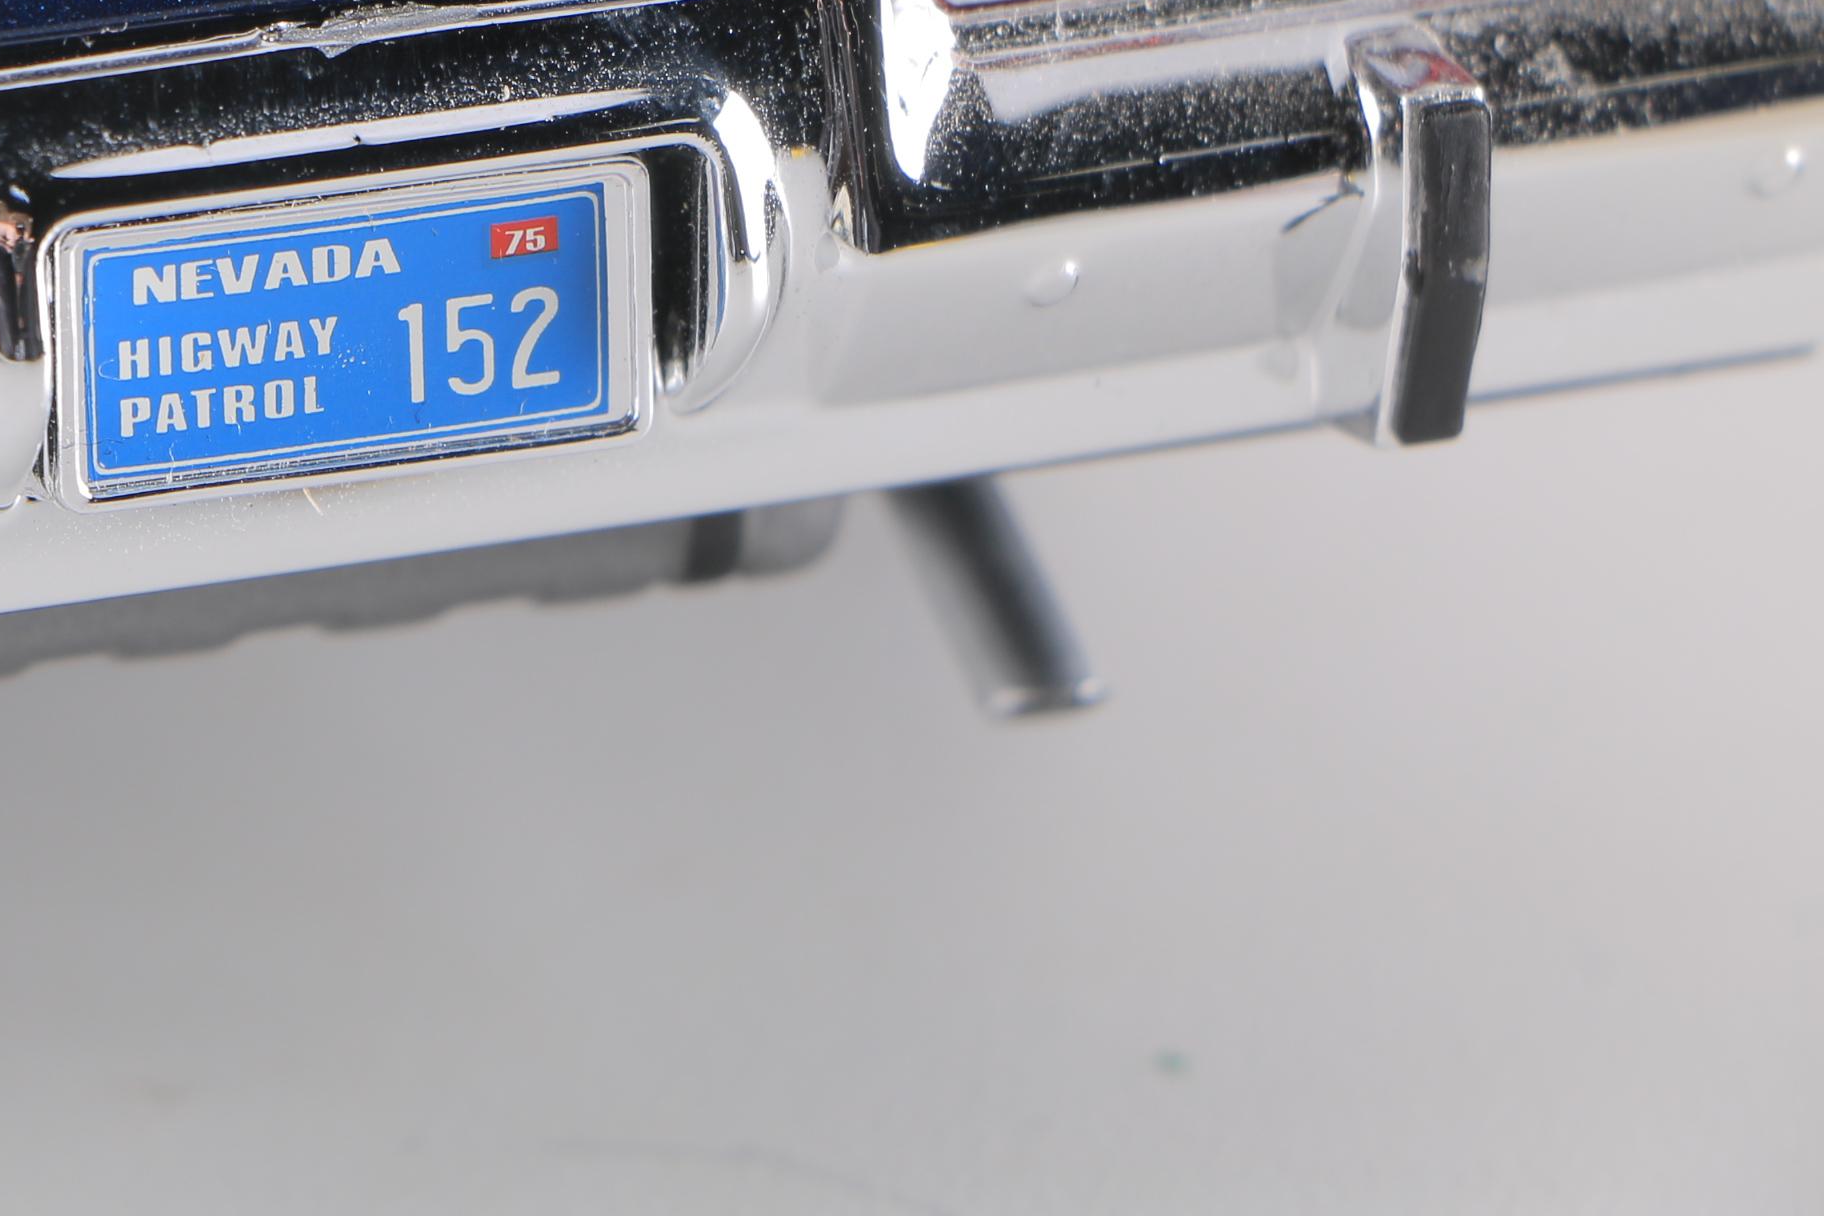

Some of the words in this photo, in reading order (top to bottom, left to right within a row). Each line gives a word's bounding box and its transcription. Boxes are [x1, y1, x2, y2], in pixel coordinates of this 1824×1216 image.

[132, 237, 402, 306] NEVADA
[504, 226, 546, 256] 75
[119, 315, 338, 380] HIGWAY
[398, 286, 561, 404] 152
[119, 375, 325, 438] PATROL
